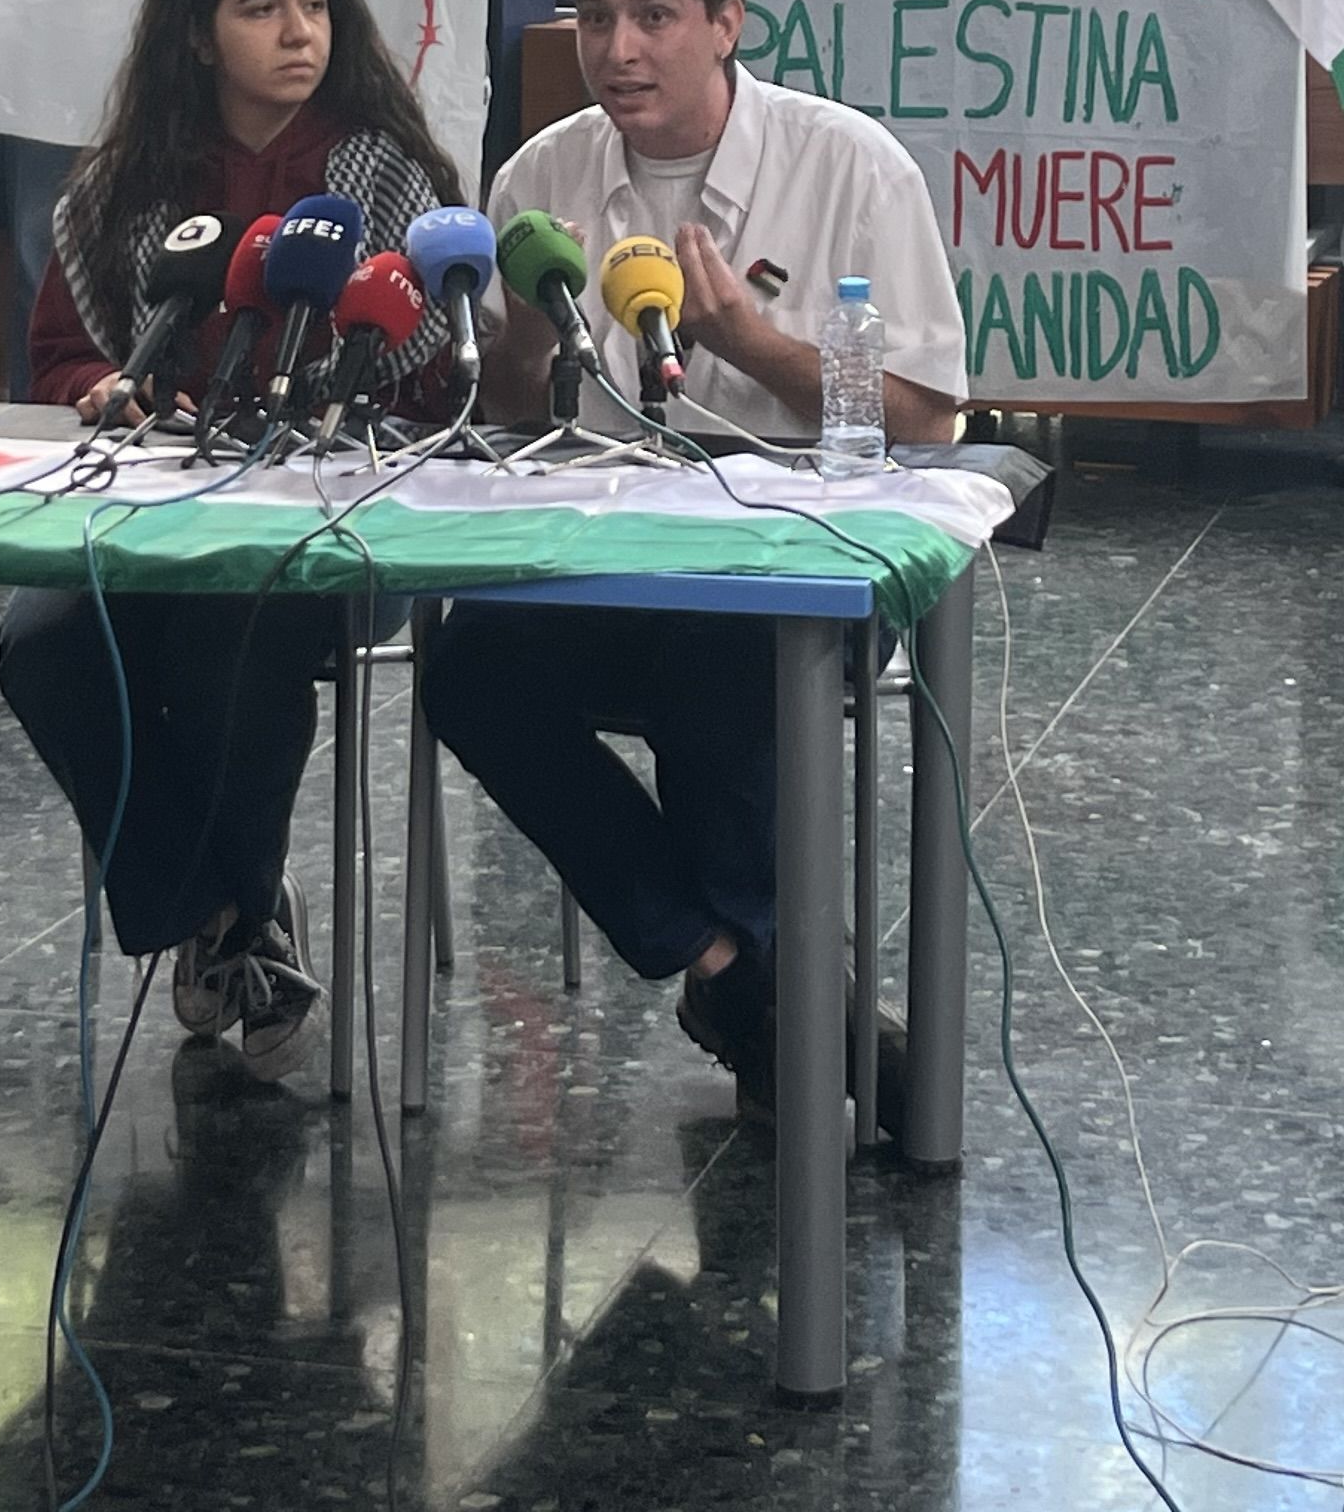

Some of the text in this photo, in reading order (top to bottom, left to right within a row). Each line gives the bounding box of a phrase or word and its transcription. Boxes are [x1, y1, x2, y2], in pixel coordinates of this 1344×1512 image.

[954, 148, 1176, 253] MUERE
[419, 211, 477, 232] tve
[389, 269, 424, 310] rne
